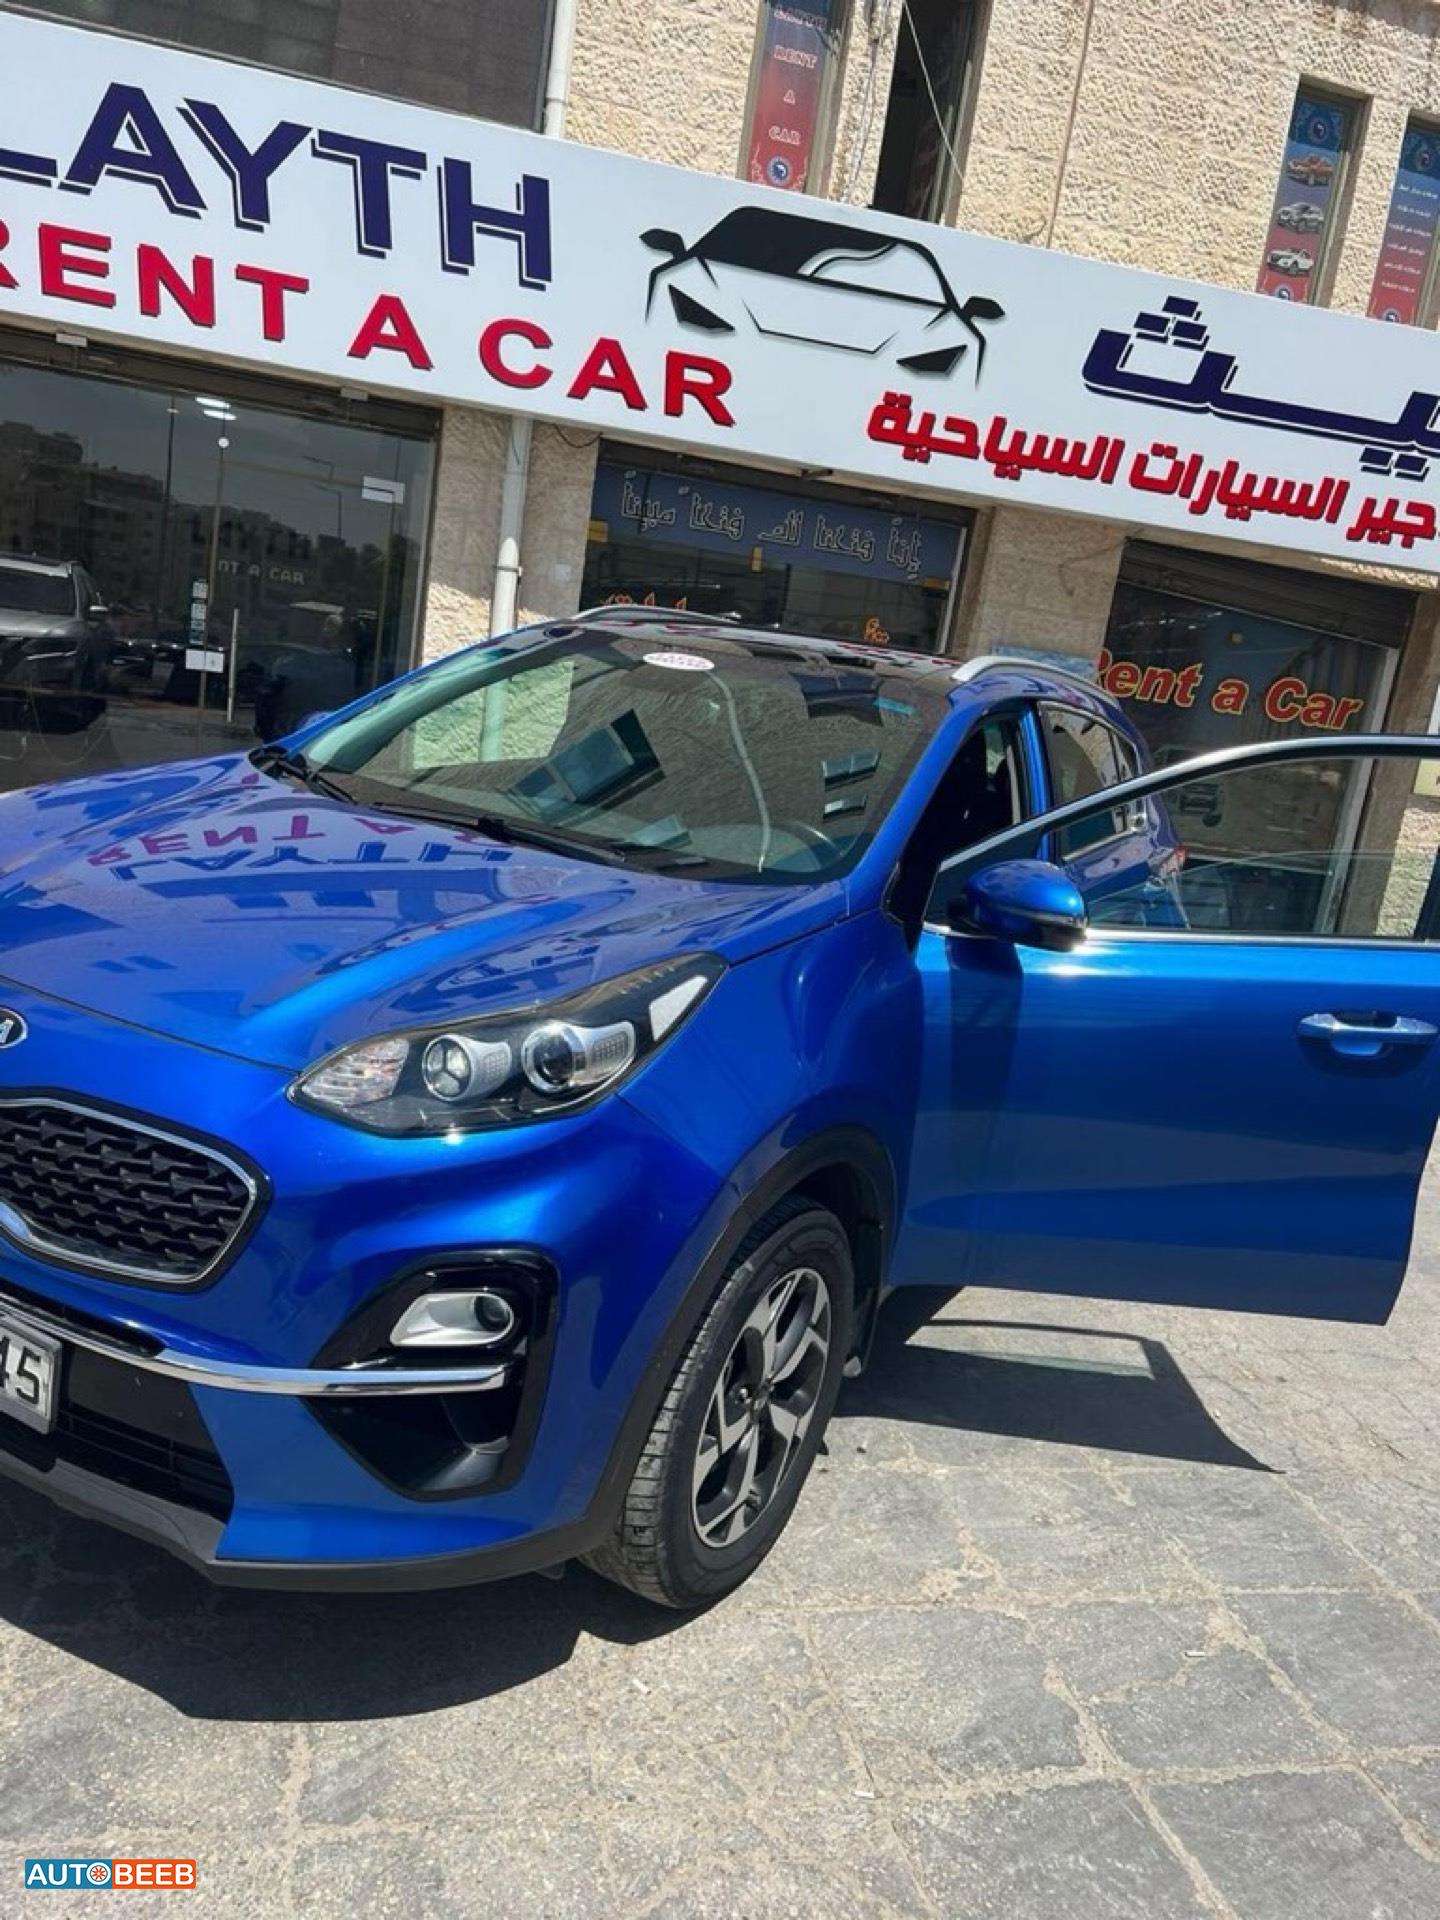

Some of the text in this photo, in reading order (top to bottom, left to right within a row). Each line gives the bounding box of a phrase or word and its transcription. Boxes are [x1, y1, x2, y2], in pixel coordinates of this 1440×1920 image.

[773, 45, 818, 69] RENT
[783, 89, 796, 105] A
[768, 125, 802, 145] CAR
[347, 293, 434, 371] A
[478, 317, 734, 427] CAR
[1081, 295, 1440, 483] يث
[866, 391, 1440, 549] جير السيارات السياحية
[269, 566, 305, 586] CAR
[1211, 676, 1250, 715] a
[1265, 676, 1364, 731] Car
